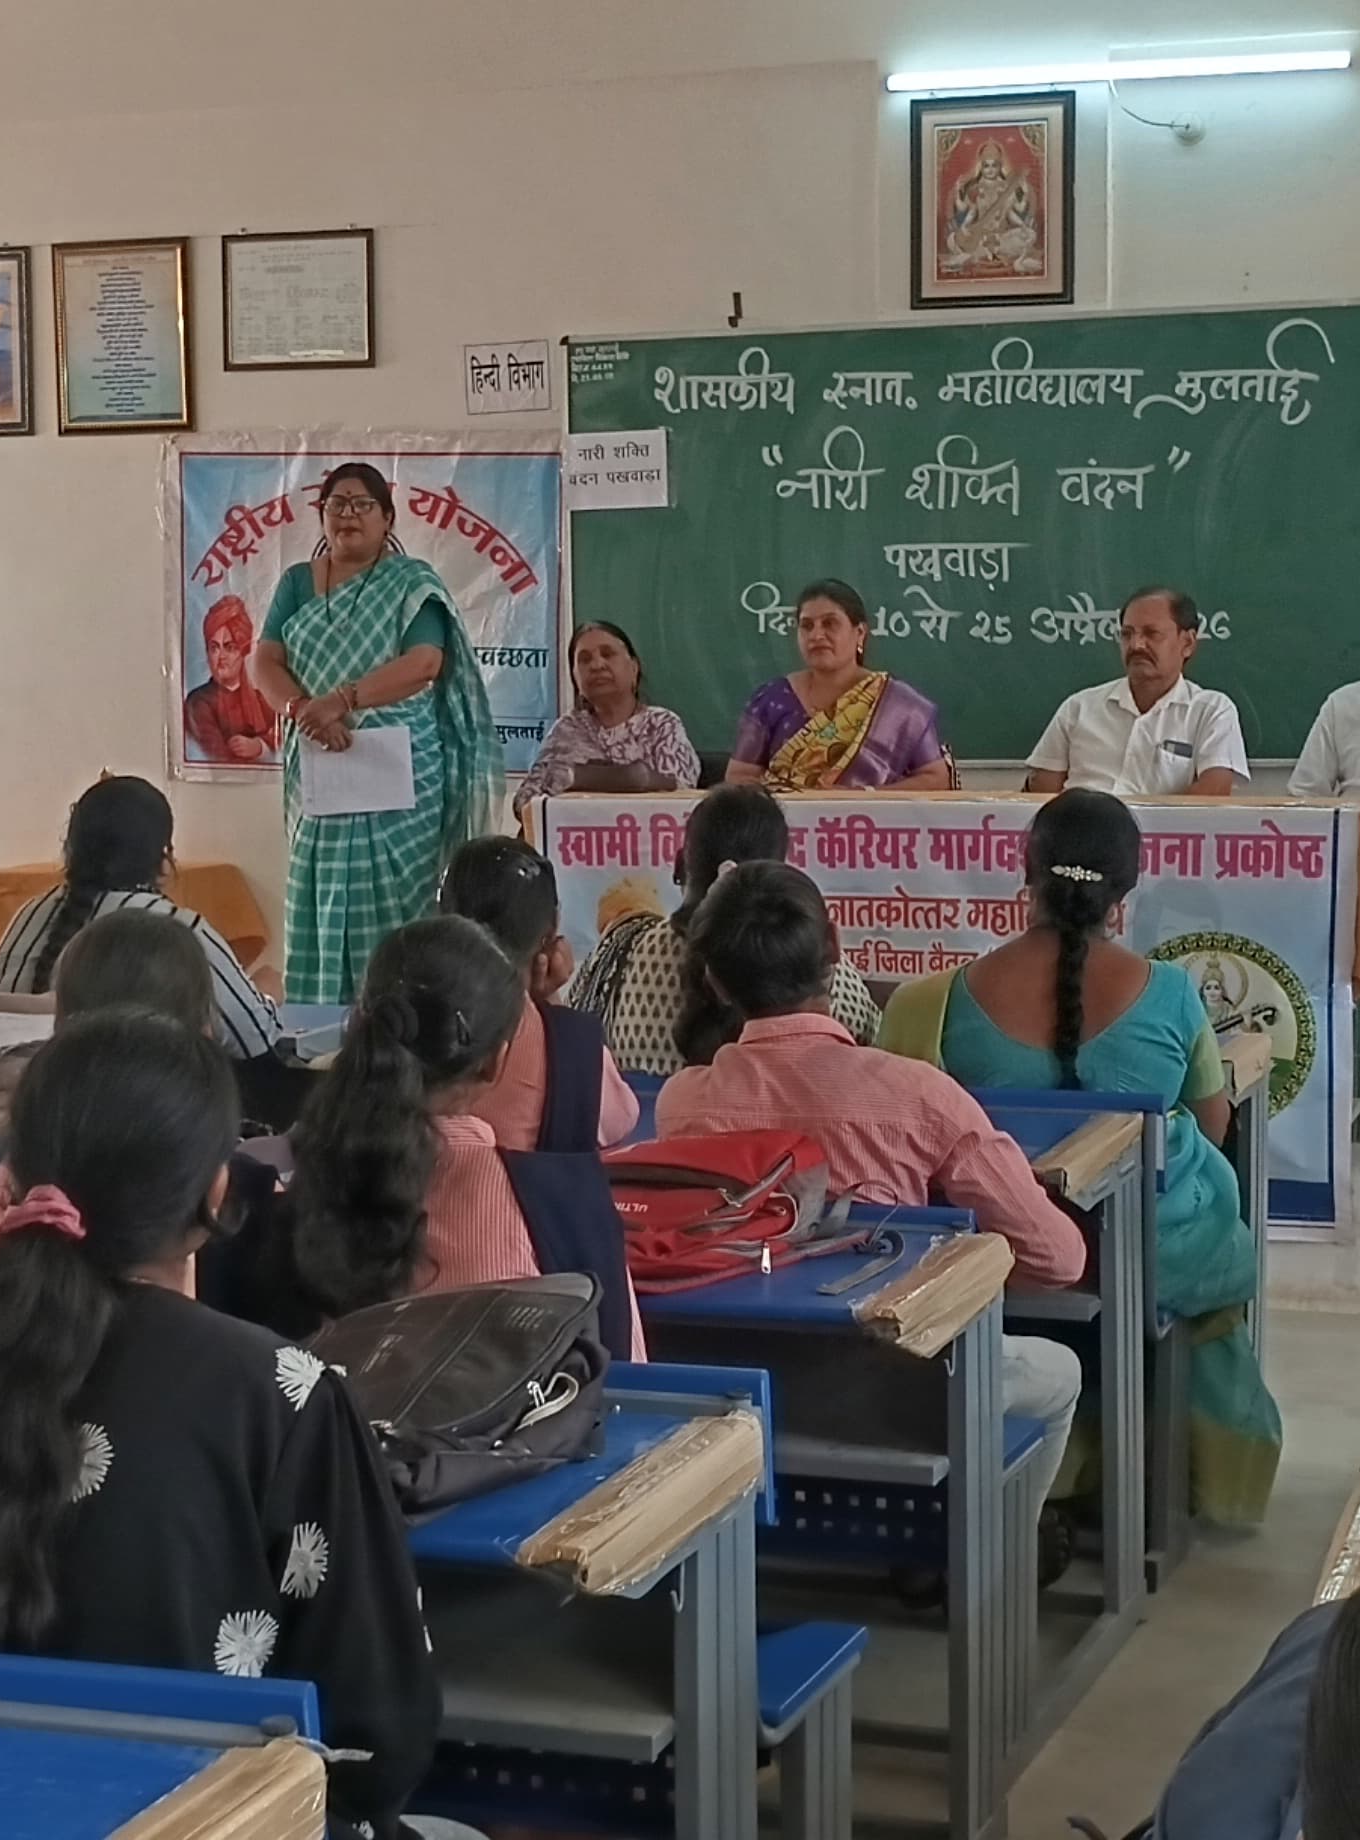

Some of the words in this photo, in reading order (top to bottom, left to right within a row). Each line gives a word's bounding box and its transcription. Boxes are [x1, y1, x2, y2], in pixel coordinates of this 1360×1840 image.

[470, 353, 501, 394] हिन्दी
[507, 353, 544, 392] विभाग
[654, 347, 795, 415] शासकीय
[938, 337, 1144, 408] महाविद्यालय
[1133, 317, 1336, 425] मुलताई
[578, 444, 605, 461] नारी
[613, 441, 649, 459] शक्ति
[905, 434, 1021, 516] शक्ति
[191, 493, 296, 589] राष्ट्रीय
[408, 485, 540, 596] योजना
[883, 541, 1030, 592] पखवाड़ा
[904, 584, 964, 642] से
[557, 813, 641, 867] स्वामी
[1215, 820, 1327, 880] प्रकोष्ठ
[874, 940, 924, 974] जिला
